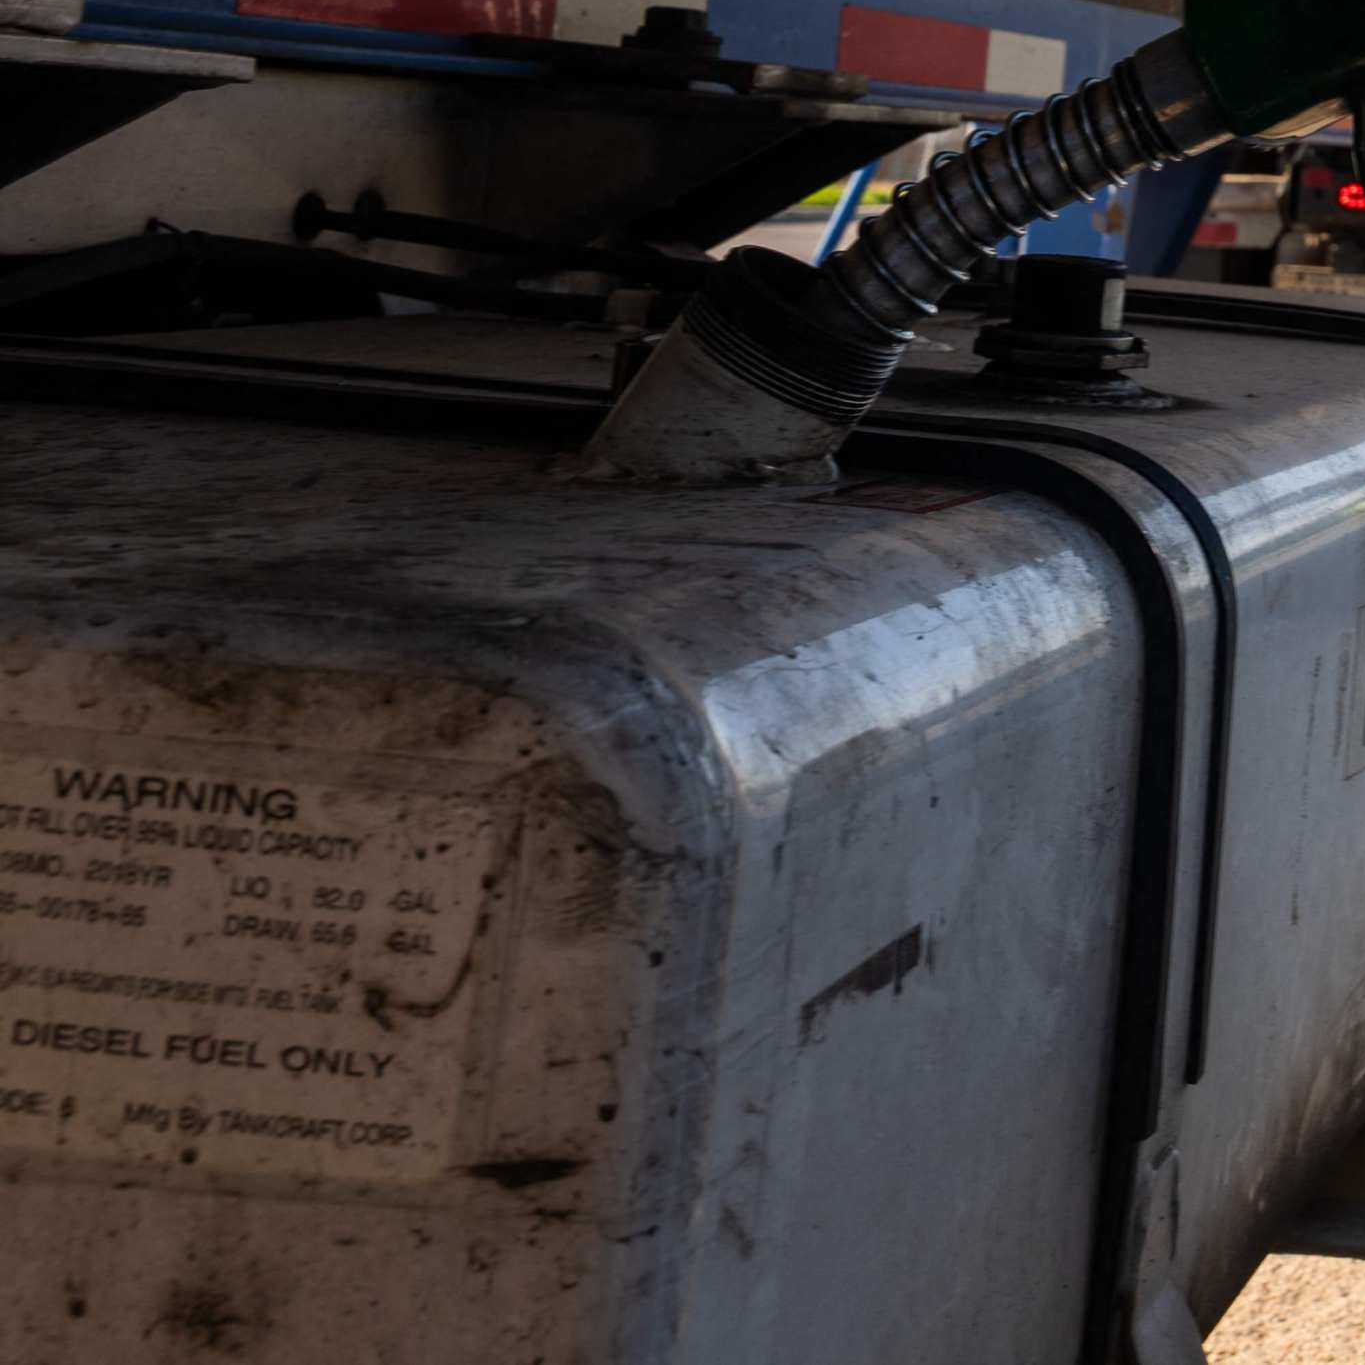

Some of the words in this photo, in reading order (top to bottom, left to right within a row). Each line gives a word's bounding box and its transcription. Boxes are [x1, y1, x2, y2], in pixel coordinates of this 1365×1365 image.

[54, 767, 299, 821] WARNING
[26, 806, 65, 835] FILL
[71, 811, 129, 842] OVER
[181, 824, 253, 854] LIQUID
[256, 829, 362, 861] CAPACITY
[11, 1019, 150, 1059] DIESEL
[163, 1034, 267, 1069] FUEL
[280, 1045, 396, 1079] ONLY
[122, 1102, 168, 1134] Mfg
[177, 1106, 210, 1138] By
